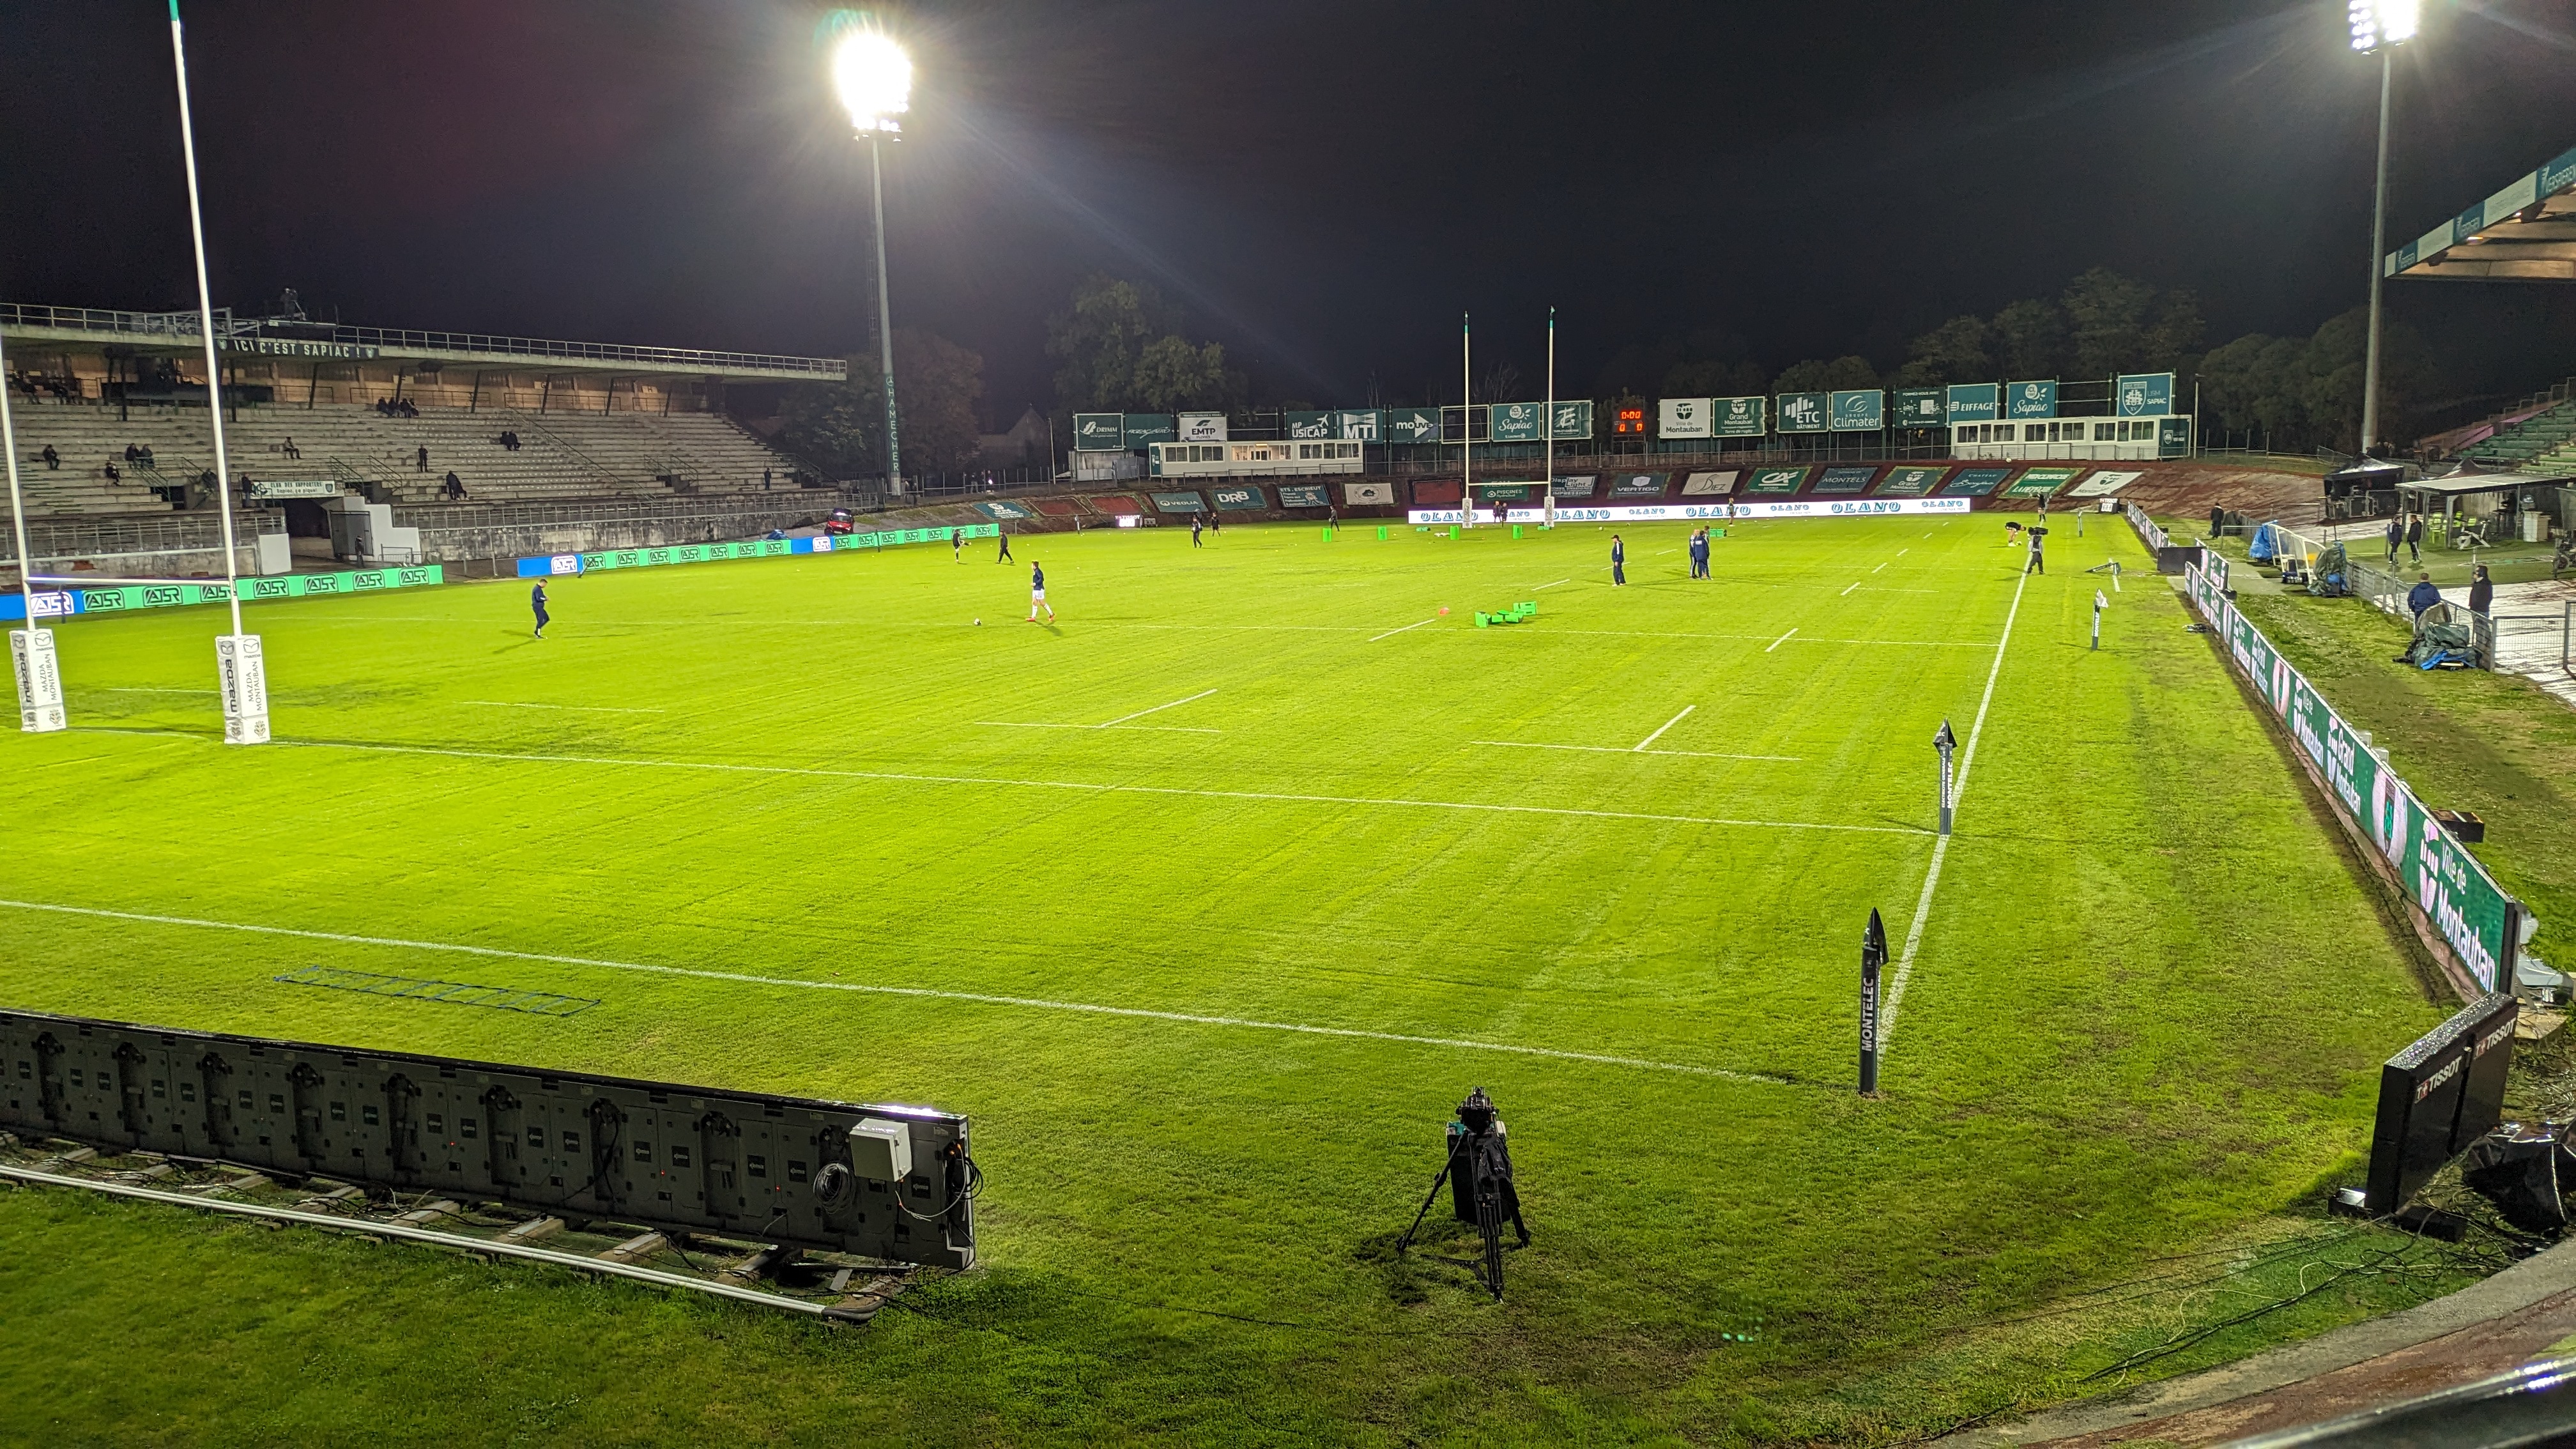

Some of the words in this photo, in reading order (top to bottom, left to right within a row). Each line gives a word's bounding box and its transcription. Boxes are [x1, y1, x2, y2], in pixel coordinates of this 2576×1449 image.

[234, 340, 254, 351] ICI
[260, 342, 296, 355] C'EST
[303, 344, 349, 358] SAPIAC
[1797, 411, 1820, 423] ETC
[1960, 402, 1995, 411] EIFFAGE
[2013, 399, 2048, 416] Sapiac
[1291, 428, 1328, 438] USICAP
[1344, 424, 1377, 439] MTI
[1498, 418, 1533, 433] Sapiac
[1834, 417, 1879, 427] Climater
[1217, 491, 1250, 503] DRB
[1831, 502, 1901, 513] OLANO
[19, 652, 32, 703] mazda
[38, 663, 49, 692] MAZDA
[44, 654, 57, 700] MONTAUBAN
[225, 659, 238, 713] mazda
[246, 671, 254, 702] MAZDA
[252, 661, 263, 711] MONTAUBAN
[2338, 727, 2356, 776] Grand
[2442, 841, 2457, 883] Ville
[2457, 861, 2467, 895] de
[2436, 880, 2496, 993] Montauban
[1861, 977, 1874, 1052] MONTELEC
[2486, 1016, 2517, 1050] TISSOT
[2428, 1055, 2462, 1092] TISSOT
